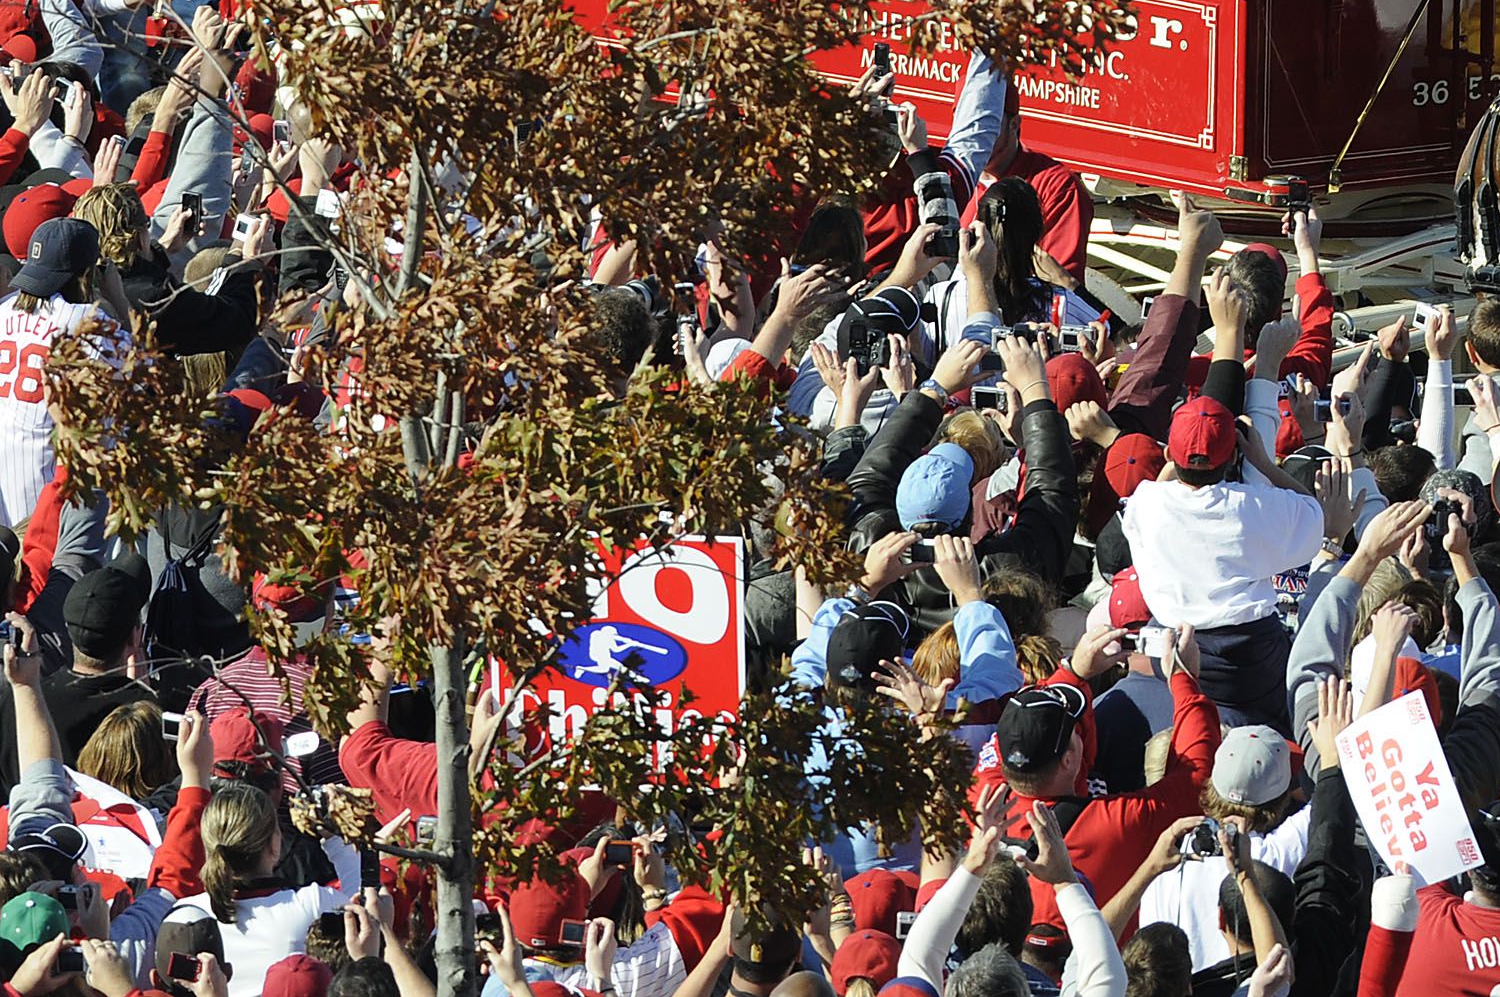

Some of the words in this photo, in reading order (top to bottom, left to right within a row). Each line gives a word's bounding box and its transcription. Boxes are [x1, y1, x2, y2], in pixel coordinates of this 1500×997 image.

[861, 48, 961, 84] MRRIMACK
[1412, 80, 1450, 107] 36
[6, 313, 59, 341] UTLEY
[1381, 738, 1428, 852] Gotta
[1415, 760, 1440, 810] Ya
